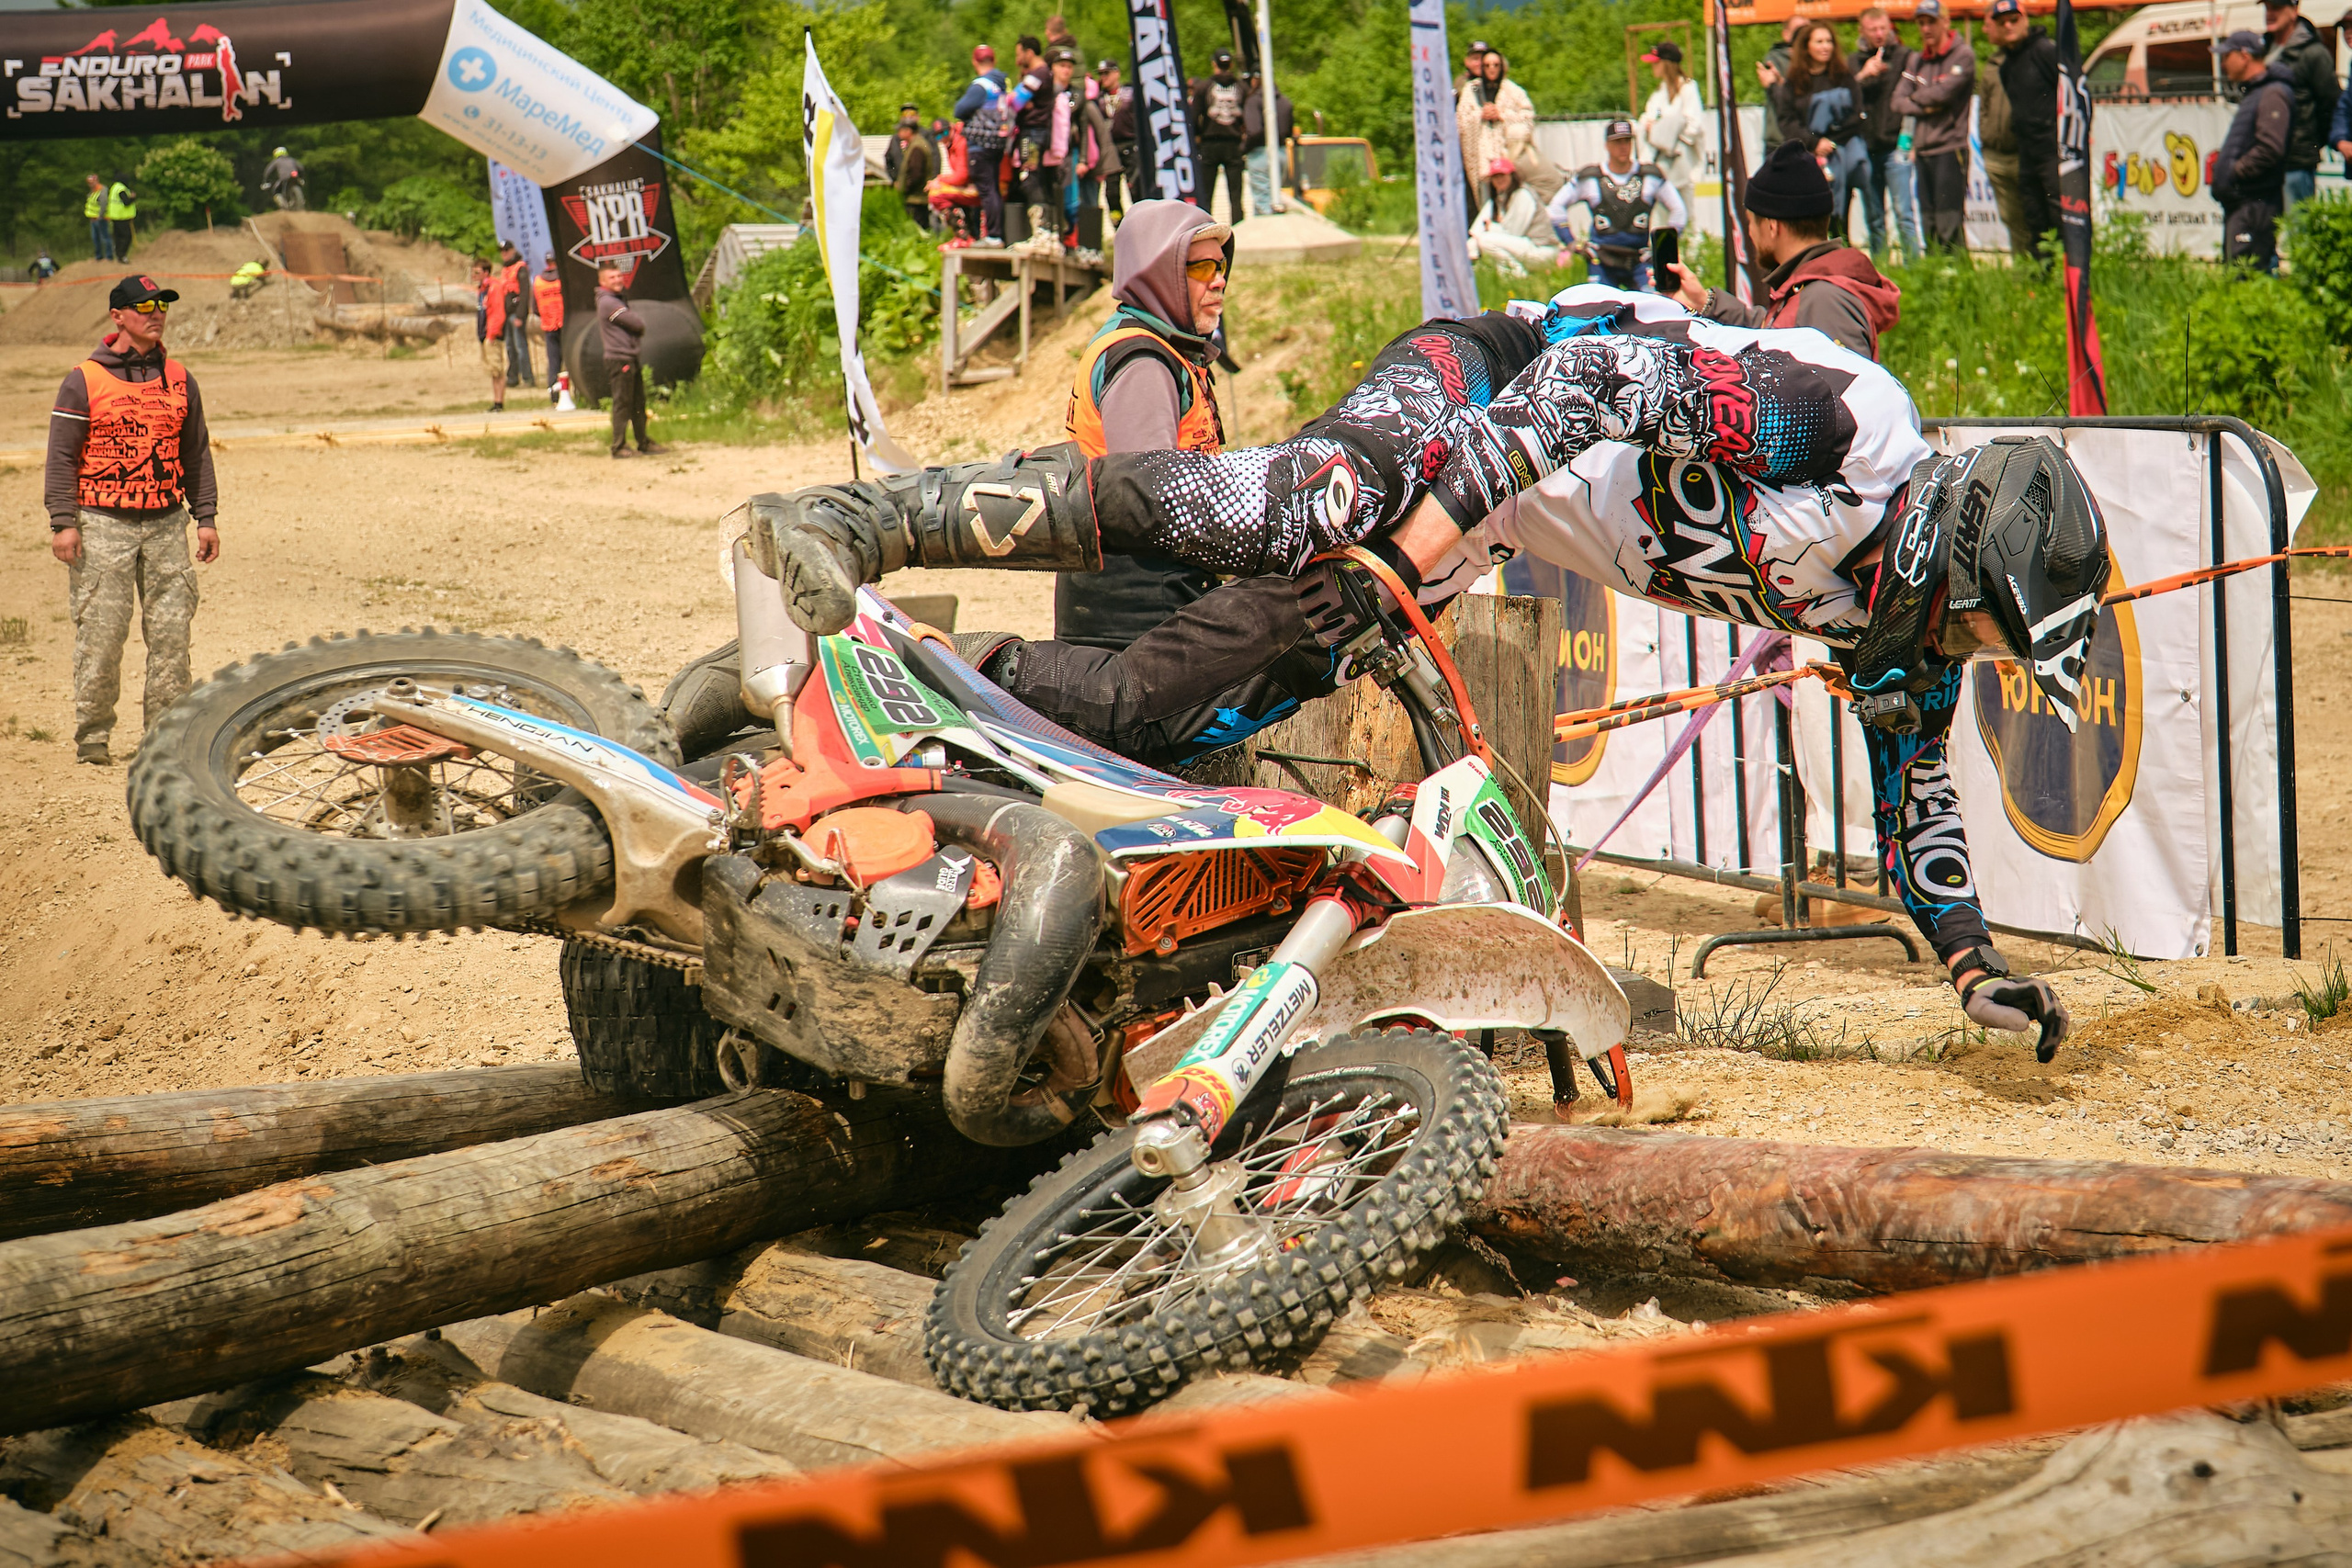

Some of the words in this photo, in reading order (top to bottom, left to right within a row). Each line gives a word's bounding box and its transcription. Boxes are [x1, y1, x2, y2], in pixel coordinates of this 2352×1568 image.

[40, 54, 183, 77] ENDURO
[187, 53, 215, 68] PARK
[469, 10, 582, 91] Медицинский
[583, 85, 634, 125] Центр
[481, 117, 548, 161] 31-13-13
[494, 77, 606, 157] МареМед
[79, 478, 160, 493] ENDURO
[1951, 479, 1992, 585] LEATT
[1948, 597, 1983, 610] LEATT
[853, 646, 941, 726] 292
[1997, 663, 2117, 726] ЮНОН
[465, 704, 595, 753] HENGJIAN
[838, 704, 871, 746] MOTOREX
[1176, 819, 1214, 838] KTM
[1434, 801, 1452, 840] KTM
[1476, 797, 1546, 917] 292
[1184, 988, 1261, 1062] MOTOREX
[1246, 979, 1311, 1066] METZELER
